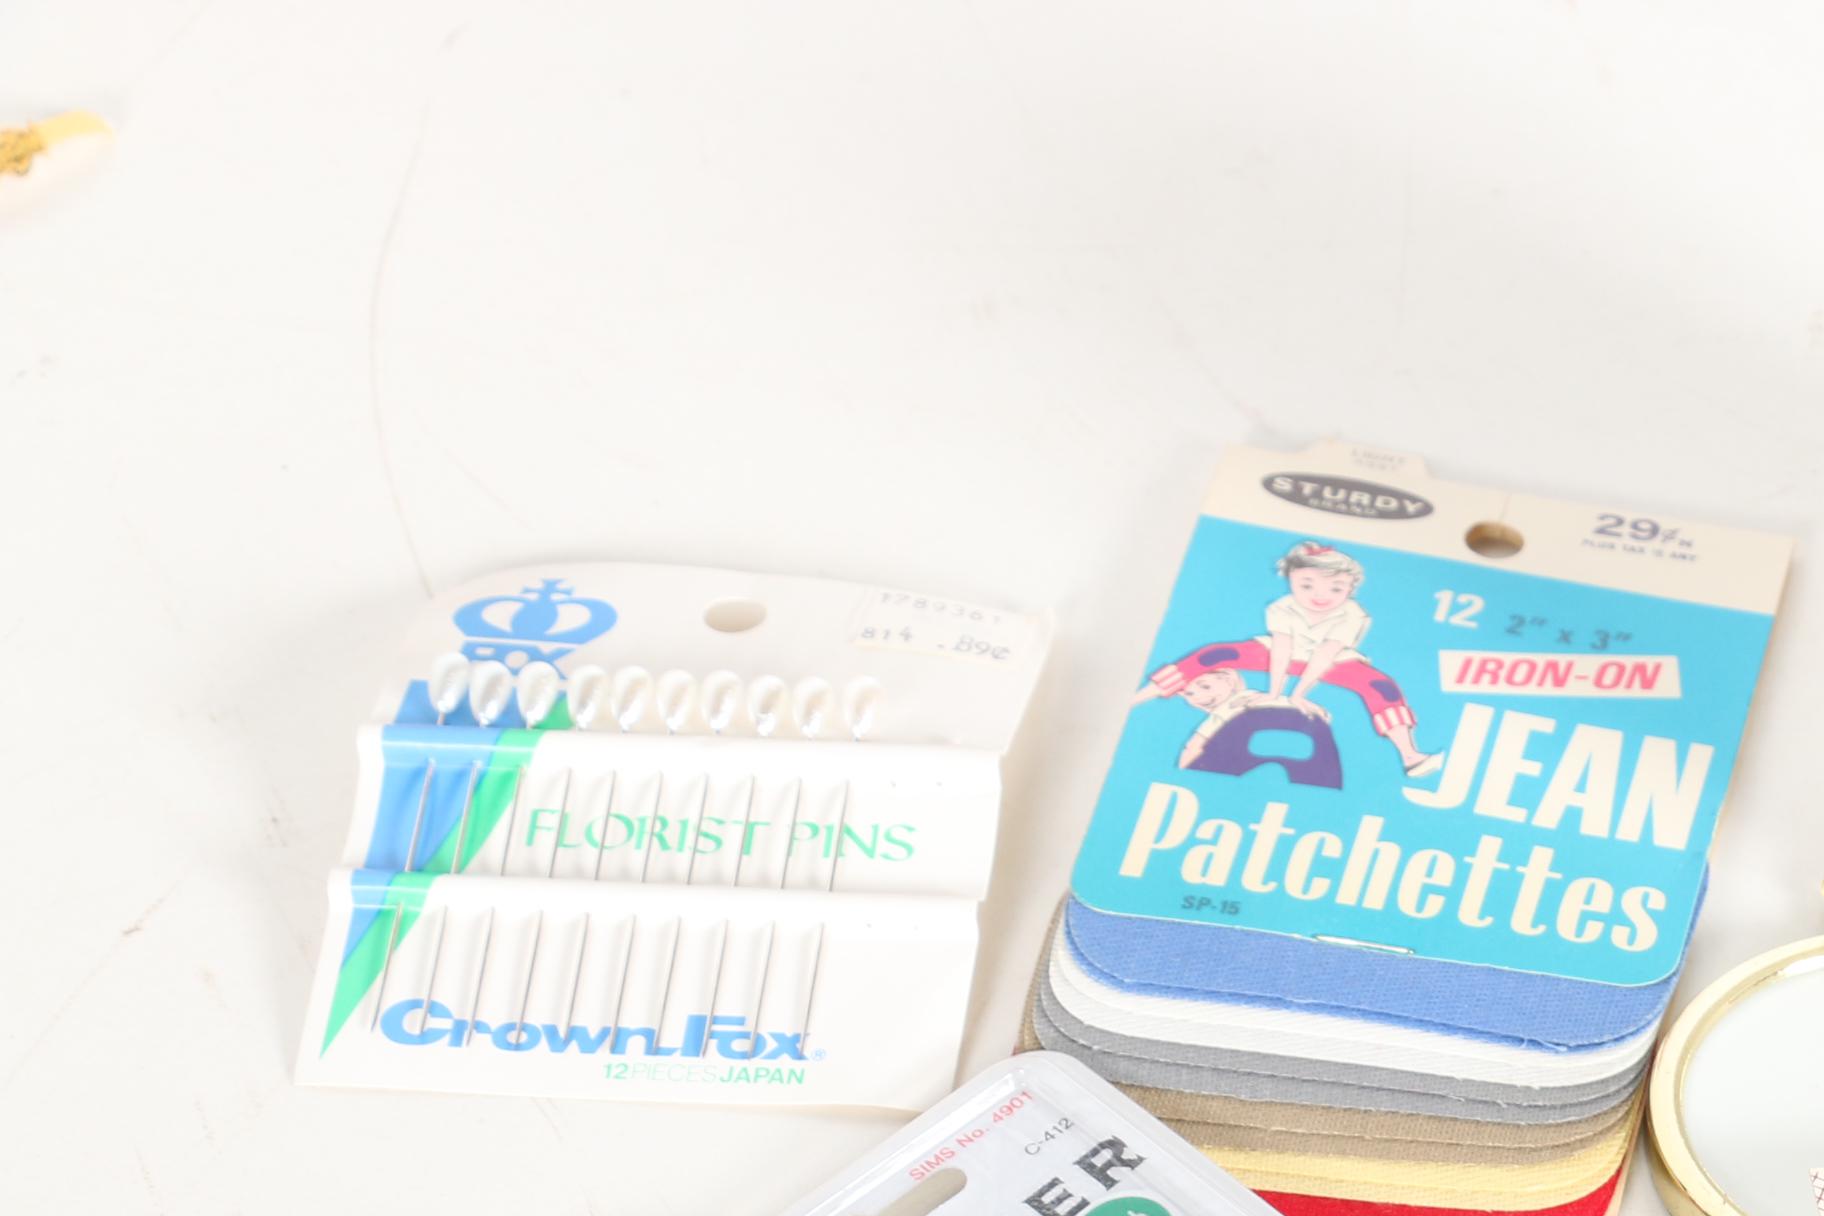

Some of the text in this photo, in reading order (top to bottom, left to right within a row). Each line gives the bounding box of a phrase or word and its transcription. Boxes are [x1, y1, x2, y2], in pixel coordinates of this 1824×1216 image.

[1271, 475, 1427, 516] STURDY
[1432, 589, 1486, 628] 12
[1454, 656, 1663, 692] IRON-ON
[1402, 702, 1715, 851] JEAN
[525, 808, 916, 862] FLORIST PINS
[1118, 781, 1667, 953] Patchettes
[1180, 895, 1240, 916] SP-15
[718, 1065, 806, 1085] JAPAN
[909, 1090, 1034, 1182] SIMS No. 4901
[1024, 1117, 1075, 1156] C-412
